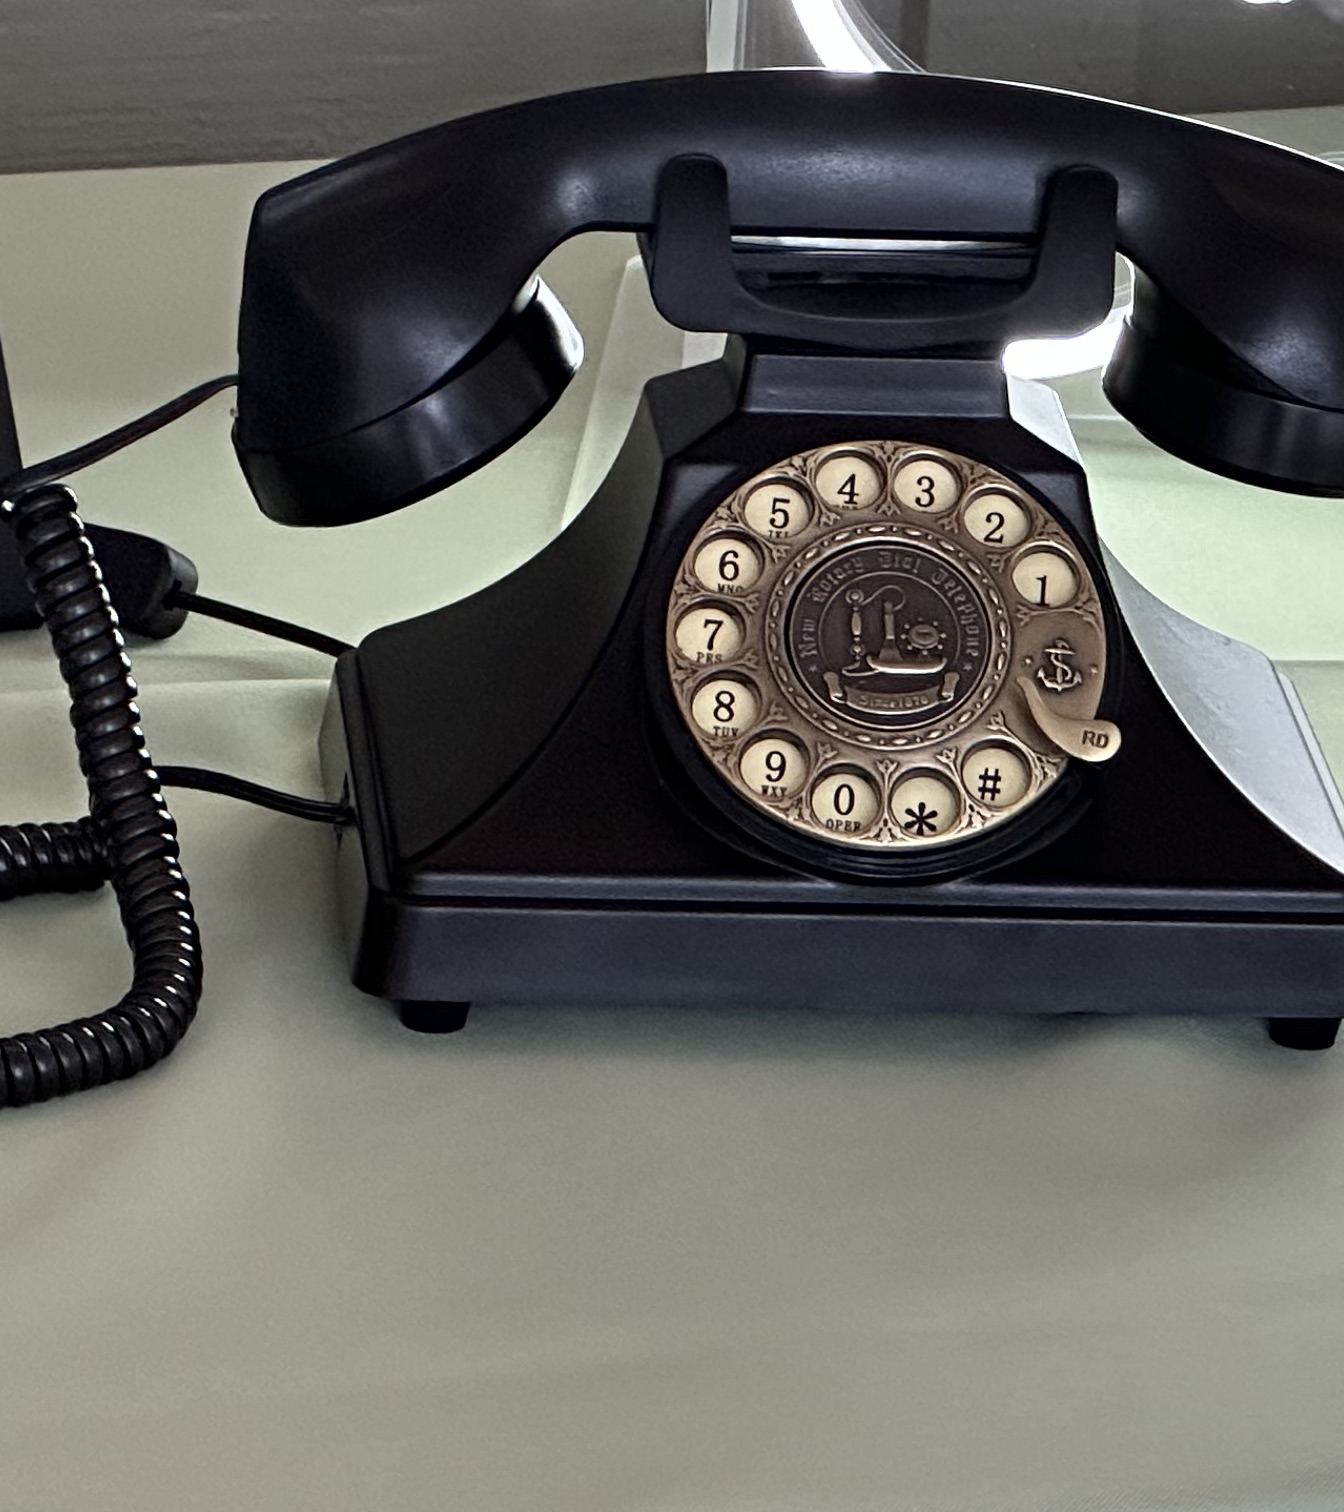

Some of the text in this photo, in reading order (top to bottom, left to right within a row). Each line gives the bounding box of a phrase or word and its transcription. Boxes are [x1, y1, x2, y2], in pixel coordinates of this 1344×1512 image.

[836, 473, 860, 505] 4
[914, 475, 936, 508] 3
[768, 497, 791, 529] 5
[983, 511, 1006, 544] 2
[718, 549, 740, 582] 6
[1035, 574, 1050, 607] 1
[703, 618, 724, 651] 7
[695, 651, 723, 664] PRS
[713, 690, 735, 722] 8
[712, 725, 739, 738] TUV
[1081, 729, 1109, 749] RD
[764, 750, 787, 783] 9
[760, 784, 788, 797] WXY
[977, 767, 1002, 801] #
[825, 818, 861, 832] OPER
